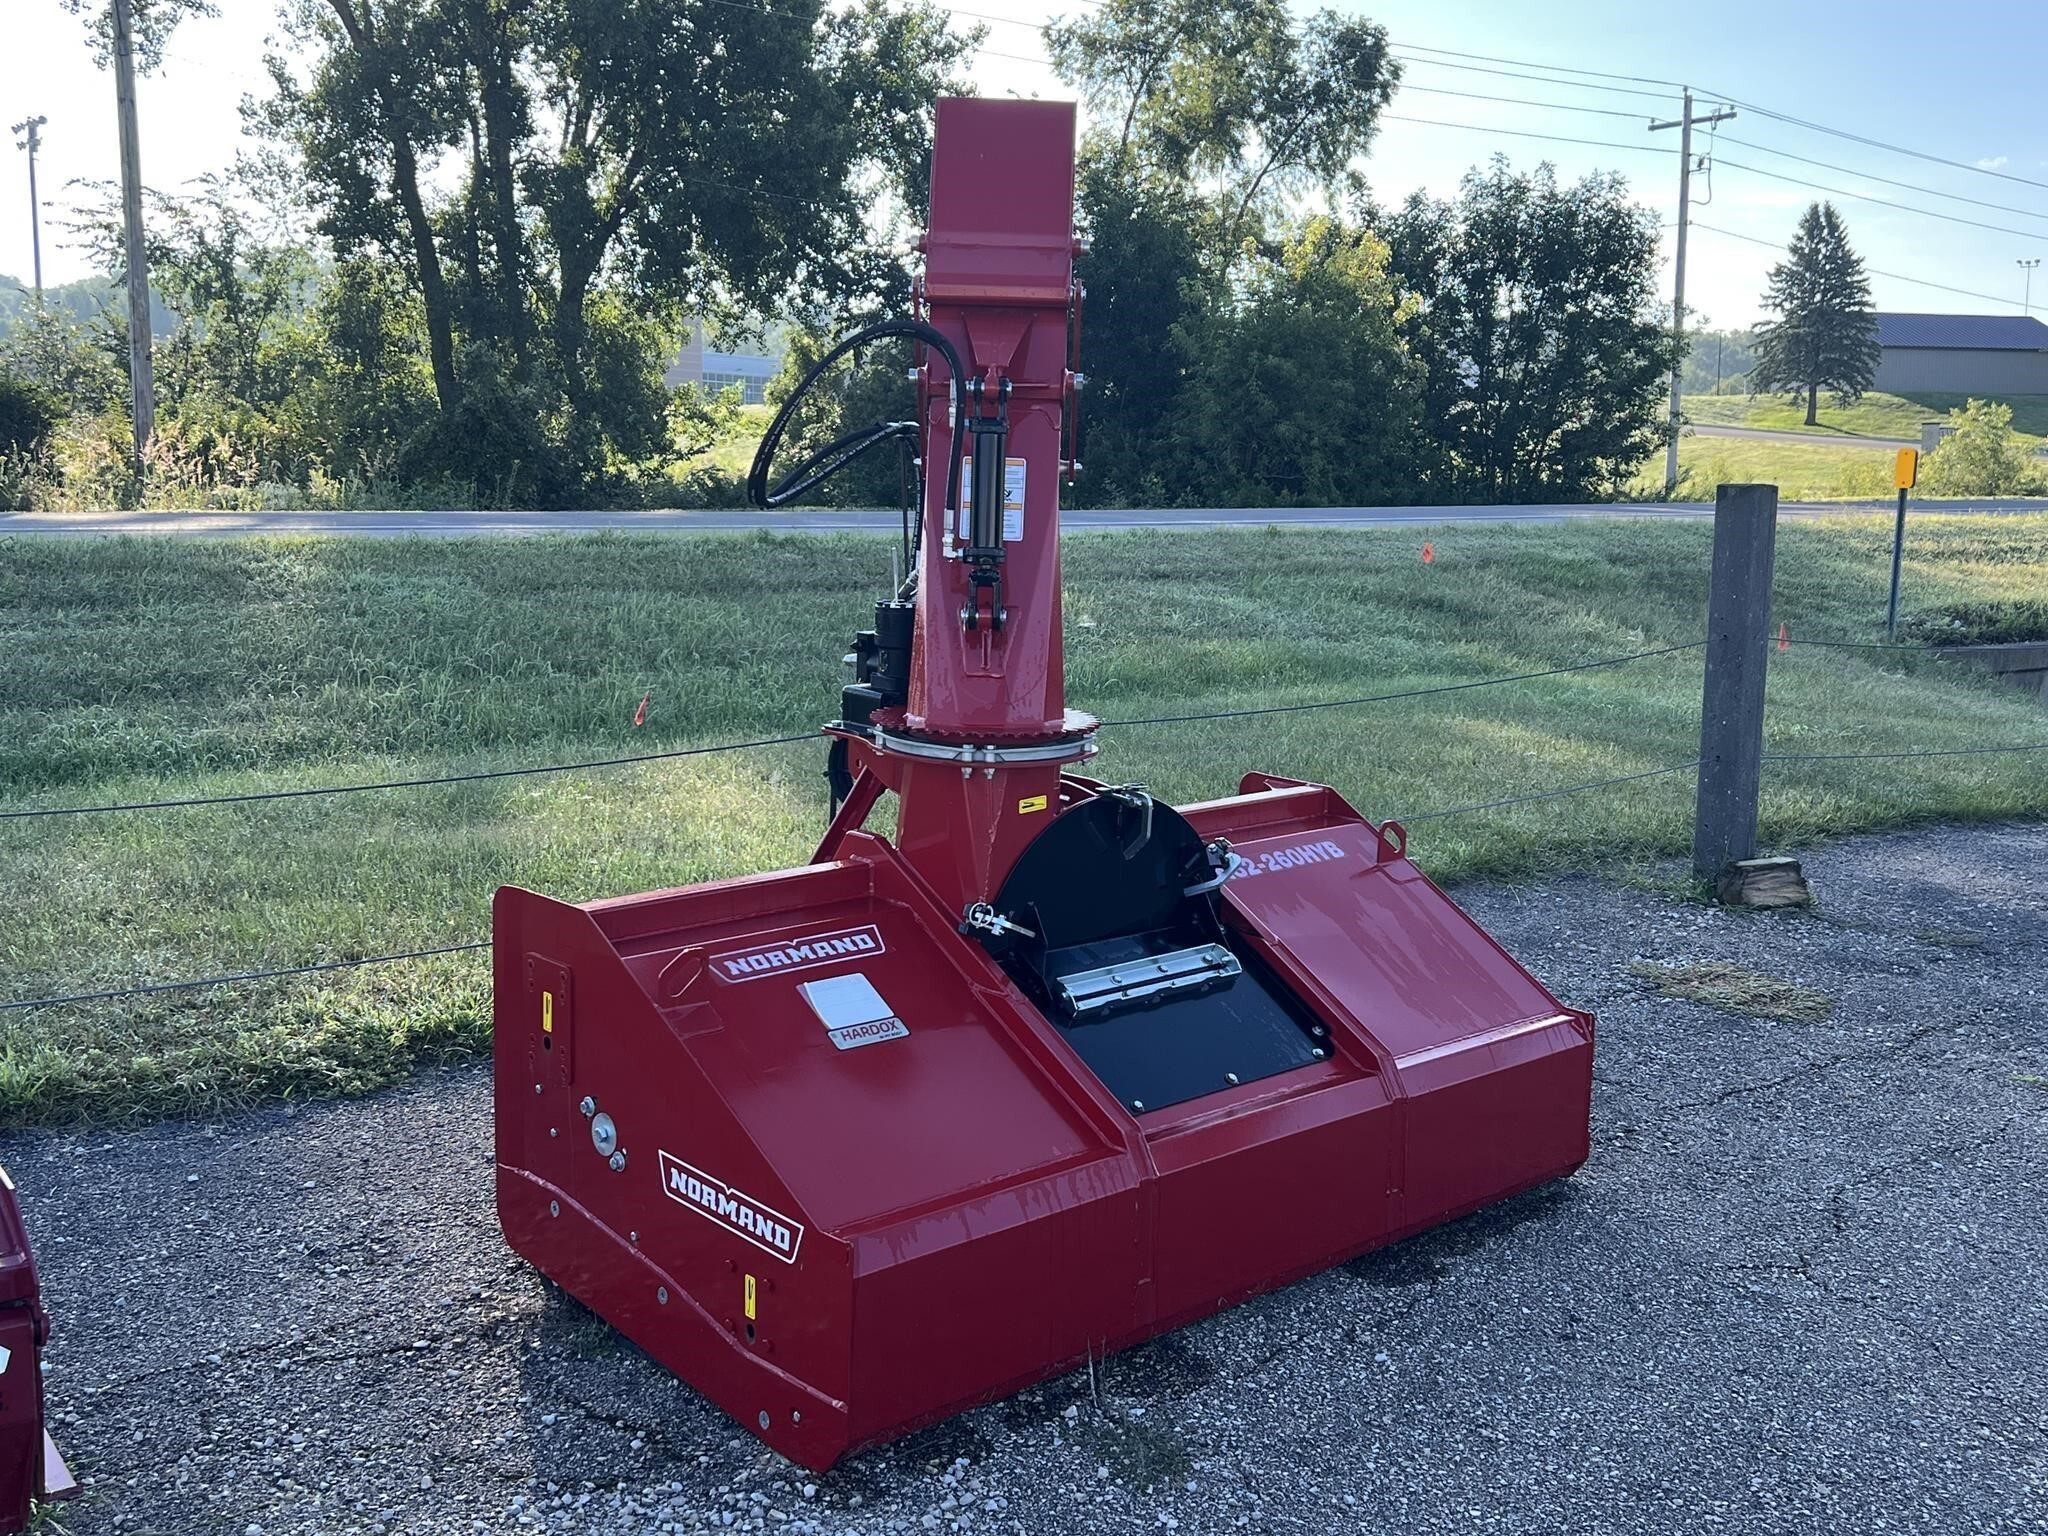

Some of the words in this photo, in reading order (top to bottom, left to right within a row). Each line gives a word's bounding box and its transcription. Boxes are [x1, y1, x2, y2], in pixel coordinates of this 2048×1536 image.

[724, 934, 875, 975] NORMAND
[840, 1020, 899, 1041] HARDOX
[670, 1167, 790, 1251] NORMAND
